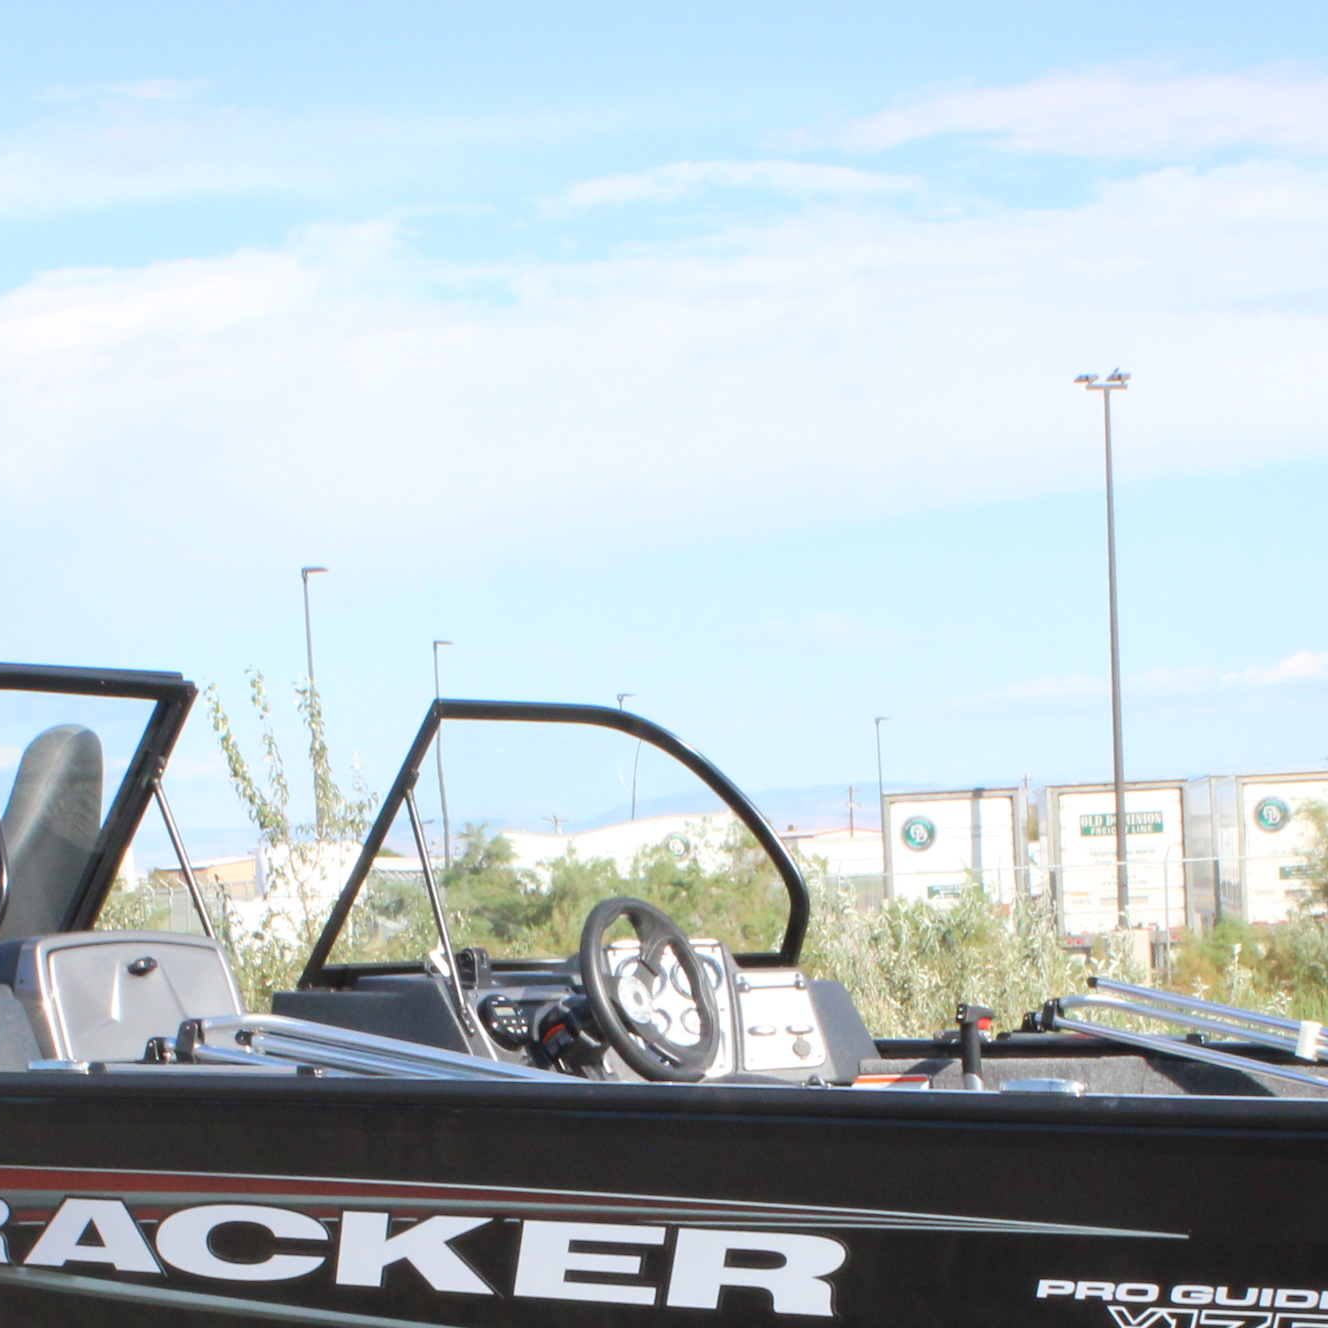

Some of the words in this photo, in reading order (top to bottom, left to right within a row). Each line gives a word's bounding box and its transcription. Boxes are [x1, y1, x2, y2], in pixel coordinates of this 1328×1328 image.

[1080, 815, 1103, 827] OLD
[1131, 824, 1154, 834] LINE
[1036, 1279, 1160, 1302] PRO
